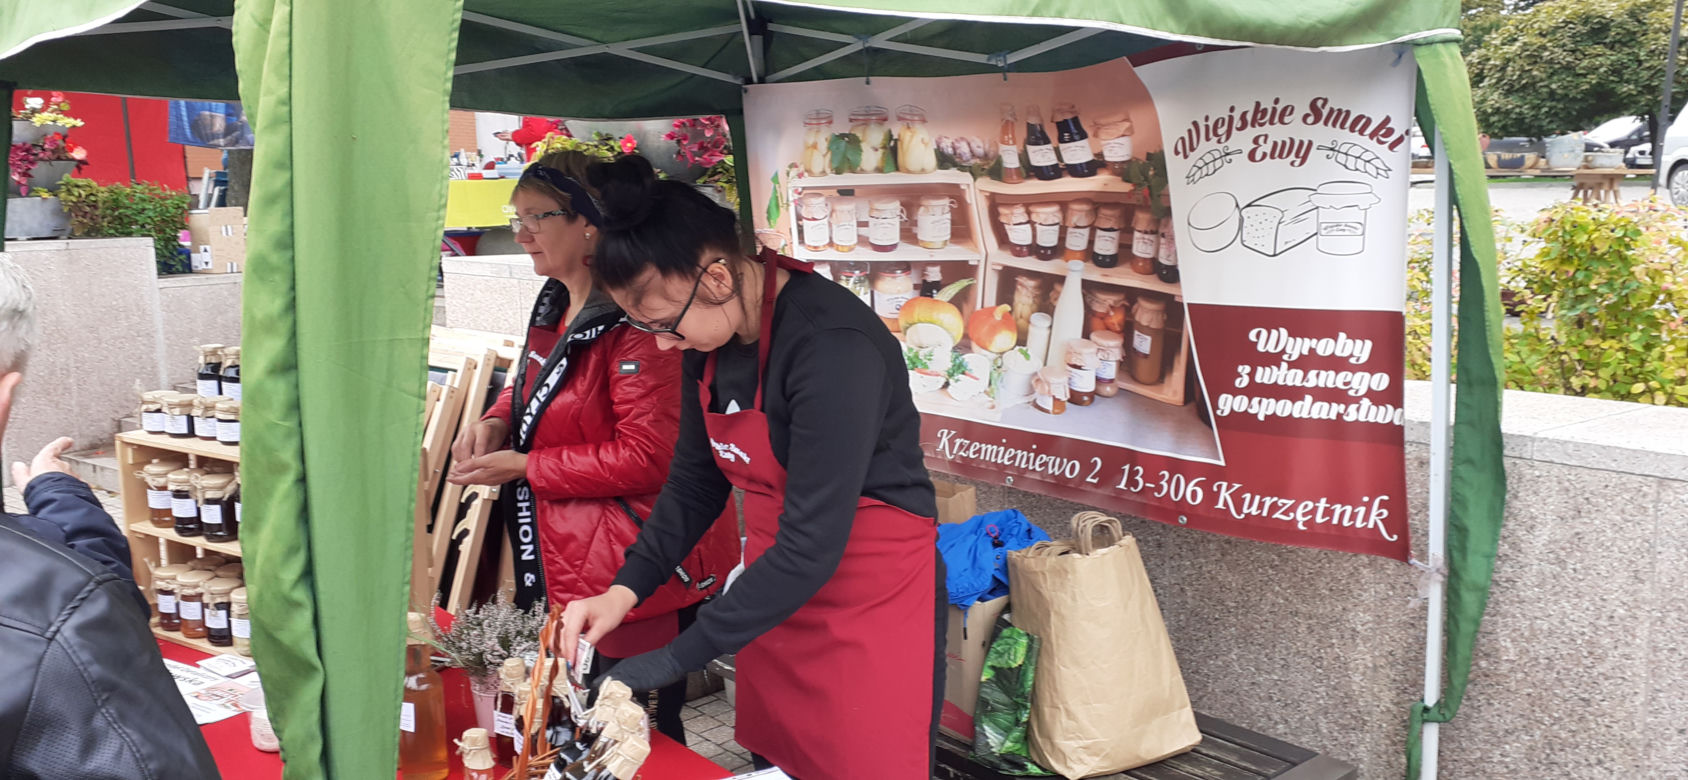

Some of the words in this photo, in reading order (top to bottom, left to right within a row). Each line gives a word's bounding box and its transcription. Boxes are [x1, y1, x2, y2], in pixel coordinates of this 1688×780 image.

[1174, 97, 1295, 160] Wiejskie
[1302, 96, 1410, 153] Smaki
[1247, 133, 1314, 167] Ewy
[1248, 327, 1373, 364] Wyroby
[1254, 361, 1390, 397] własnego
[936, 428, 1081, 479] Krzemieniewo
[1085, 457, 1102, 484] 2
[1115, 463, 1207, 505] 13-306
[1212, 481, 1399, 541] Kurzętnik
